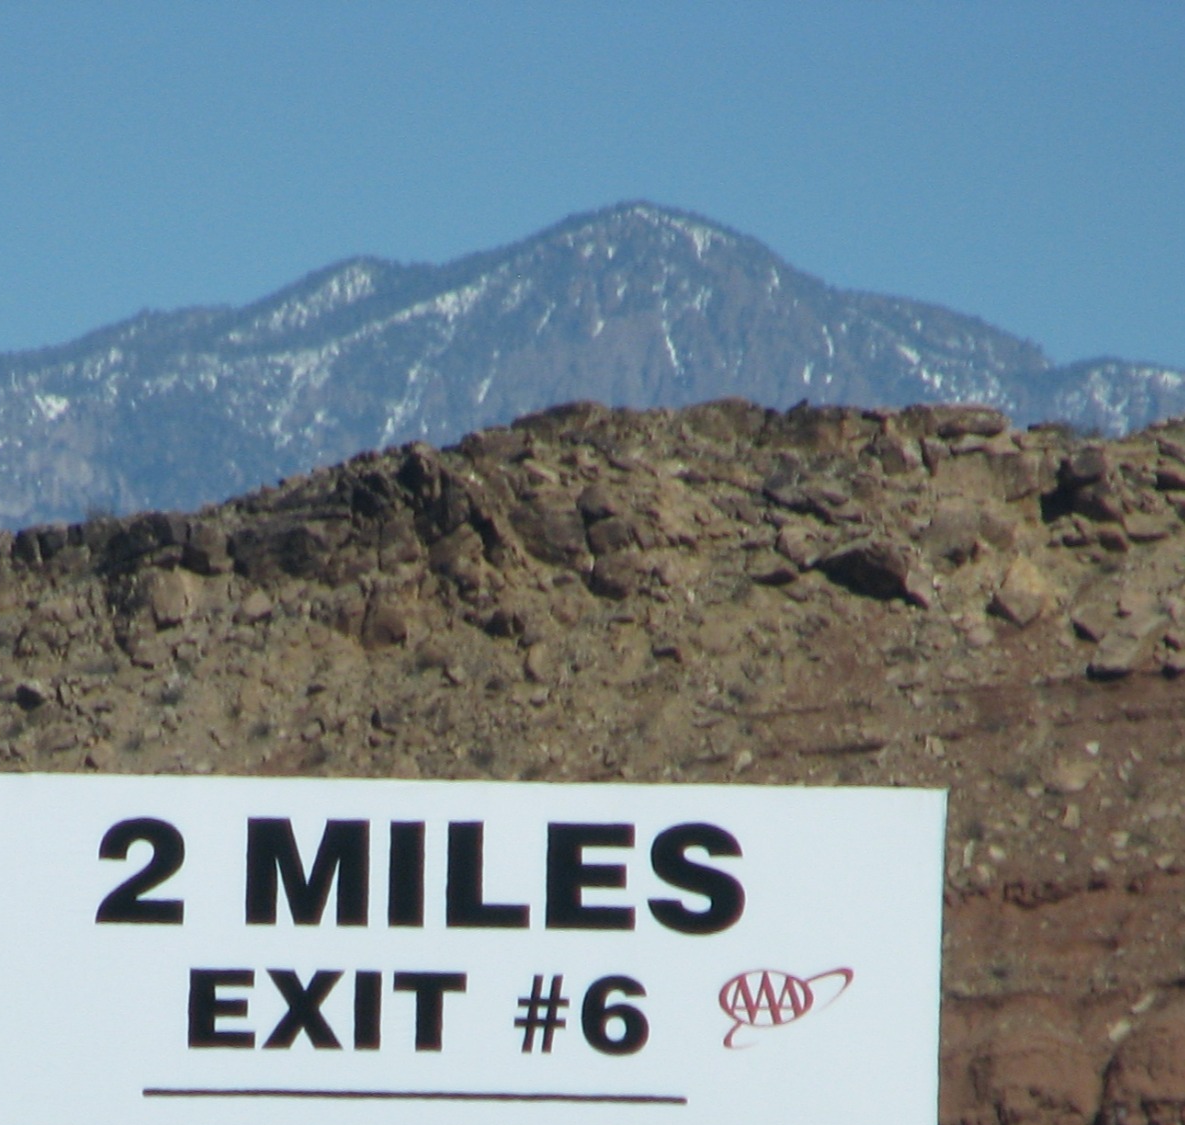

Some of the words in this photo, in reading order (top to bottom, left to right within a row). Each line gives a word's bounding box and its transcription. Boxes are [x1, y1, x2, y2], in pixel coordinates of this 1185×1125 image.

[95, 817, 186, 925] 2
[245, 816, 746, 936] MILES
[187, 967, 467, 1051] EXIT
[513, 973, 650, 1056] #6
[720, 969, 814, 1027] AAA
